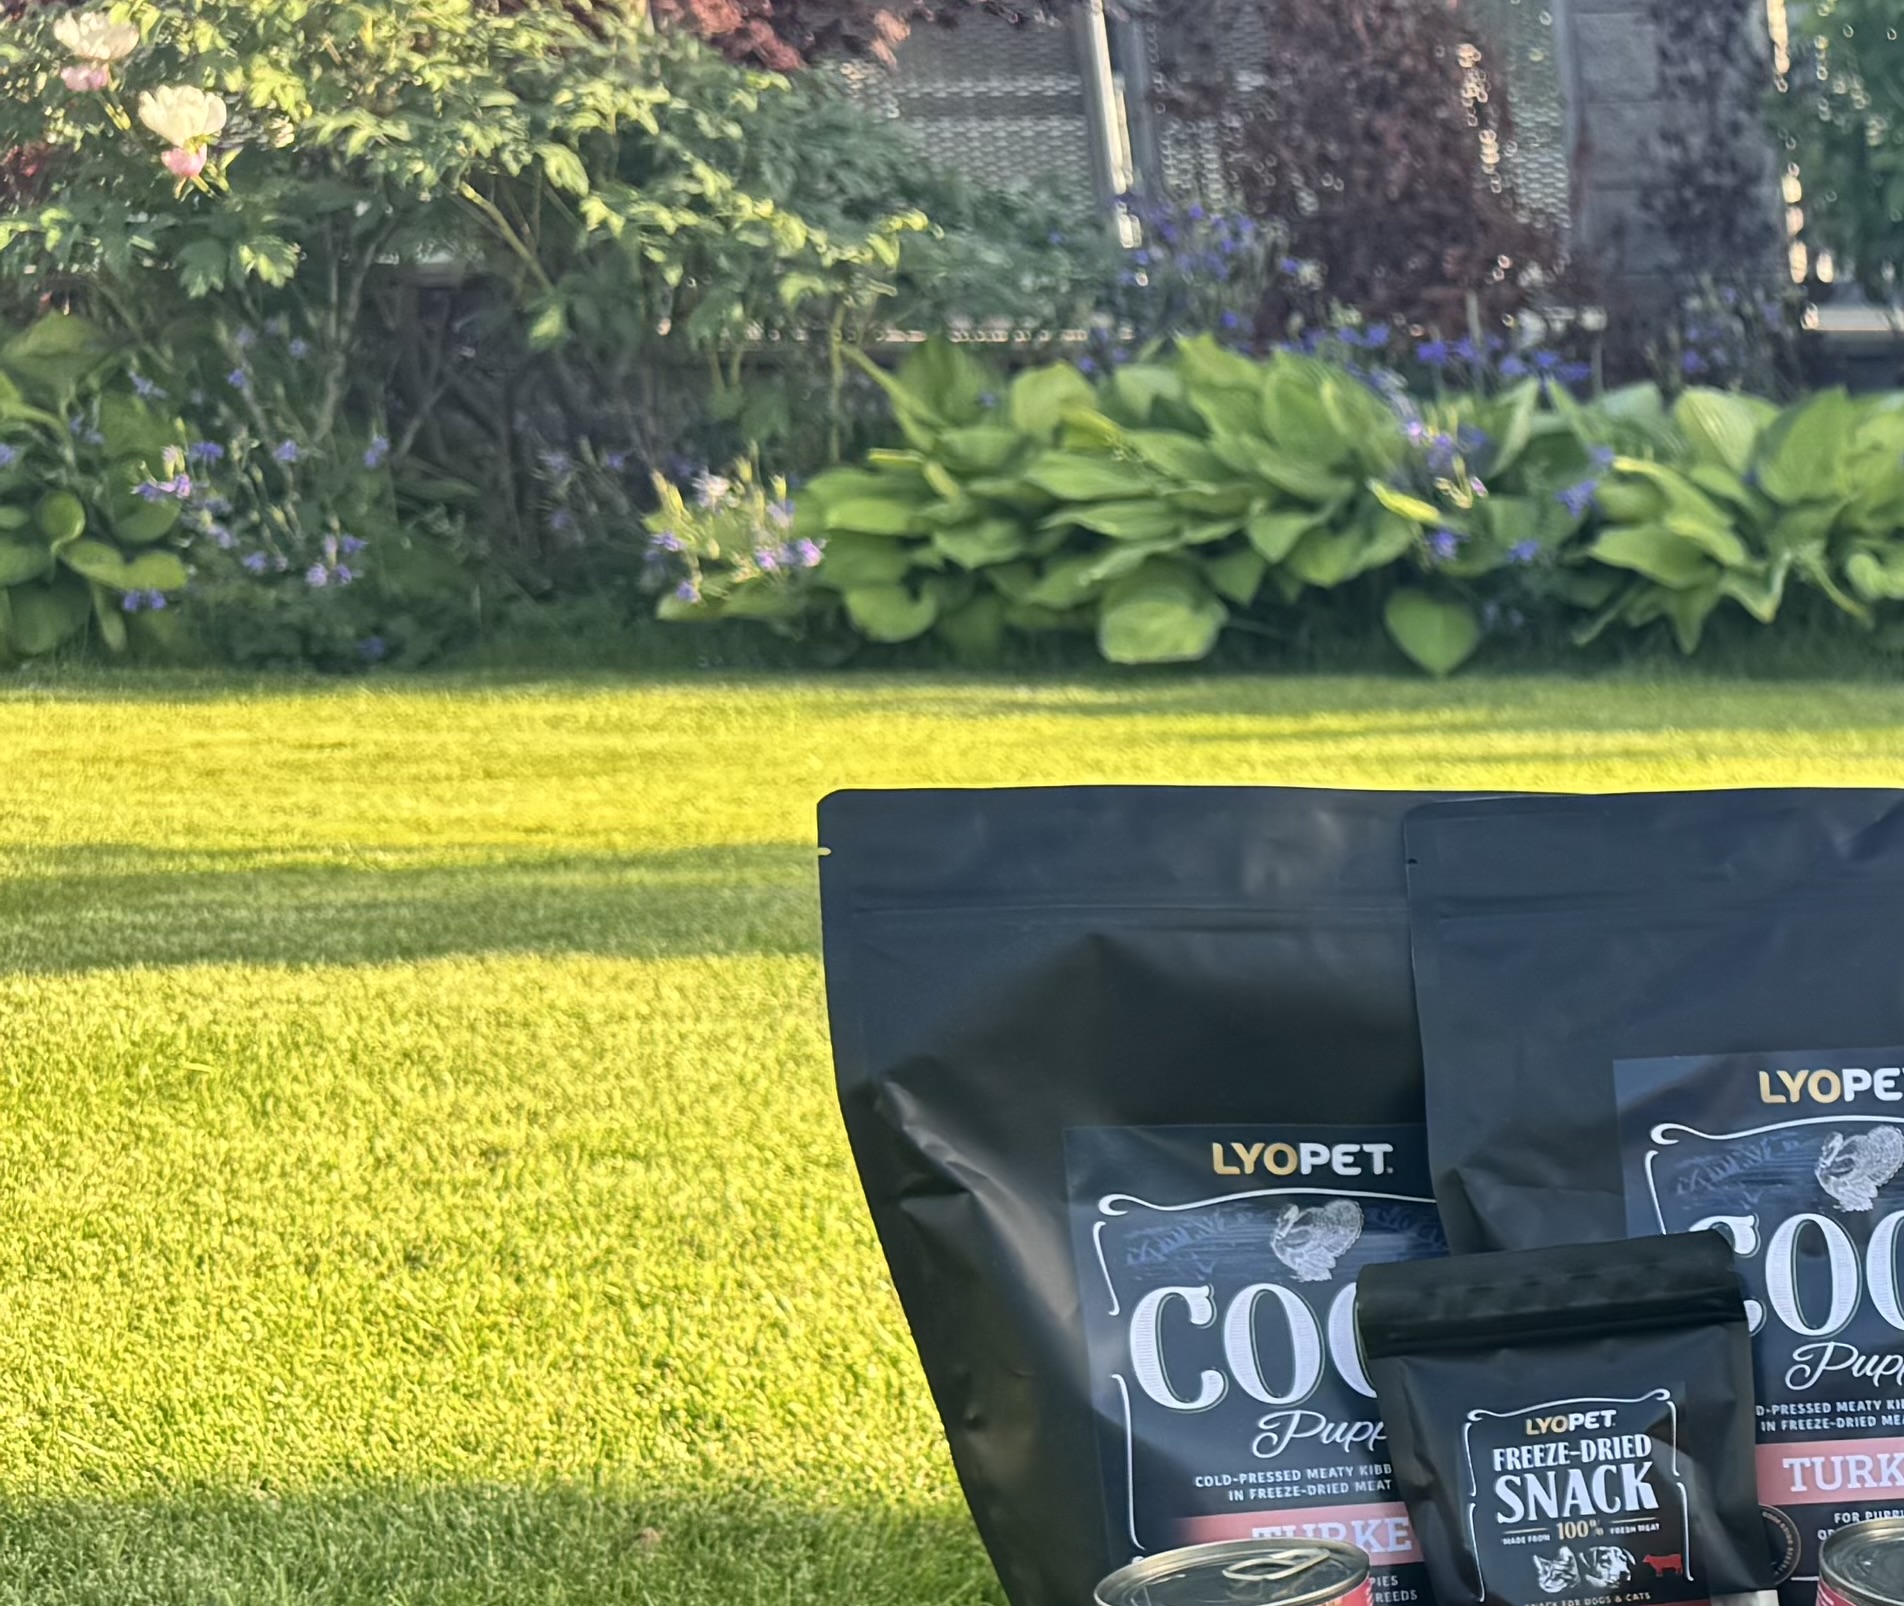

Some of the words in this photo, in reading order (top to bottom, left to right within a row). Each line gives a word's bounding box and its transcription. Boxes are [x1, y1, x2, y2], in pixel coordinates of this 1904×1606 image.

[1756, 1403, 1831, 1416] D-PRESSED
[1837, 1400, 1881, 1412] MEATY
[1761, 1421, 1775, 1431] IN
[1782, 1415, 1876, 1430] FREEZE-DRIED
[1252, 1410, 1387, 1459] Pupp
[1493, 1434, 1652, 1471] FREEZE-DRIED
[1195, 1469, 1301, 1488] COLD-PRESSED
[1307, 1466, 1354, 1480] MEATY
[1359, 1463, 1392, 1476] KIBB
[1229, 1490, 1244, 1501] IN
[1250, 1483, 1349, 1500] FREEZE-DRIED
[1355, 1479, 1392, 1492] MEAT
[1495, 1461, 1659, 1523] SNACK
[1834, 1512, 1860, 1524] FOR
[1375, 1590, 1417, 1603] REEDS
